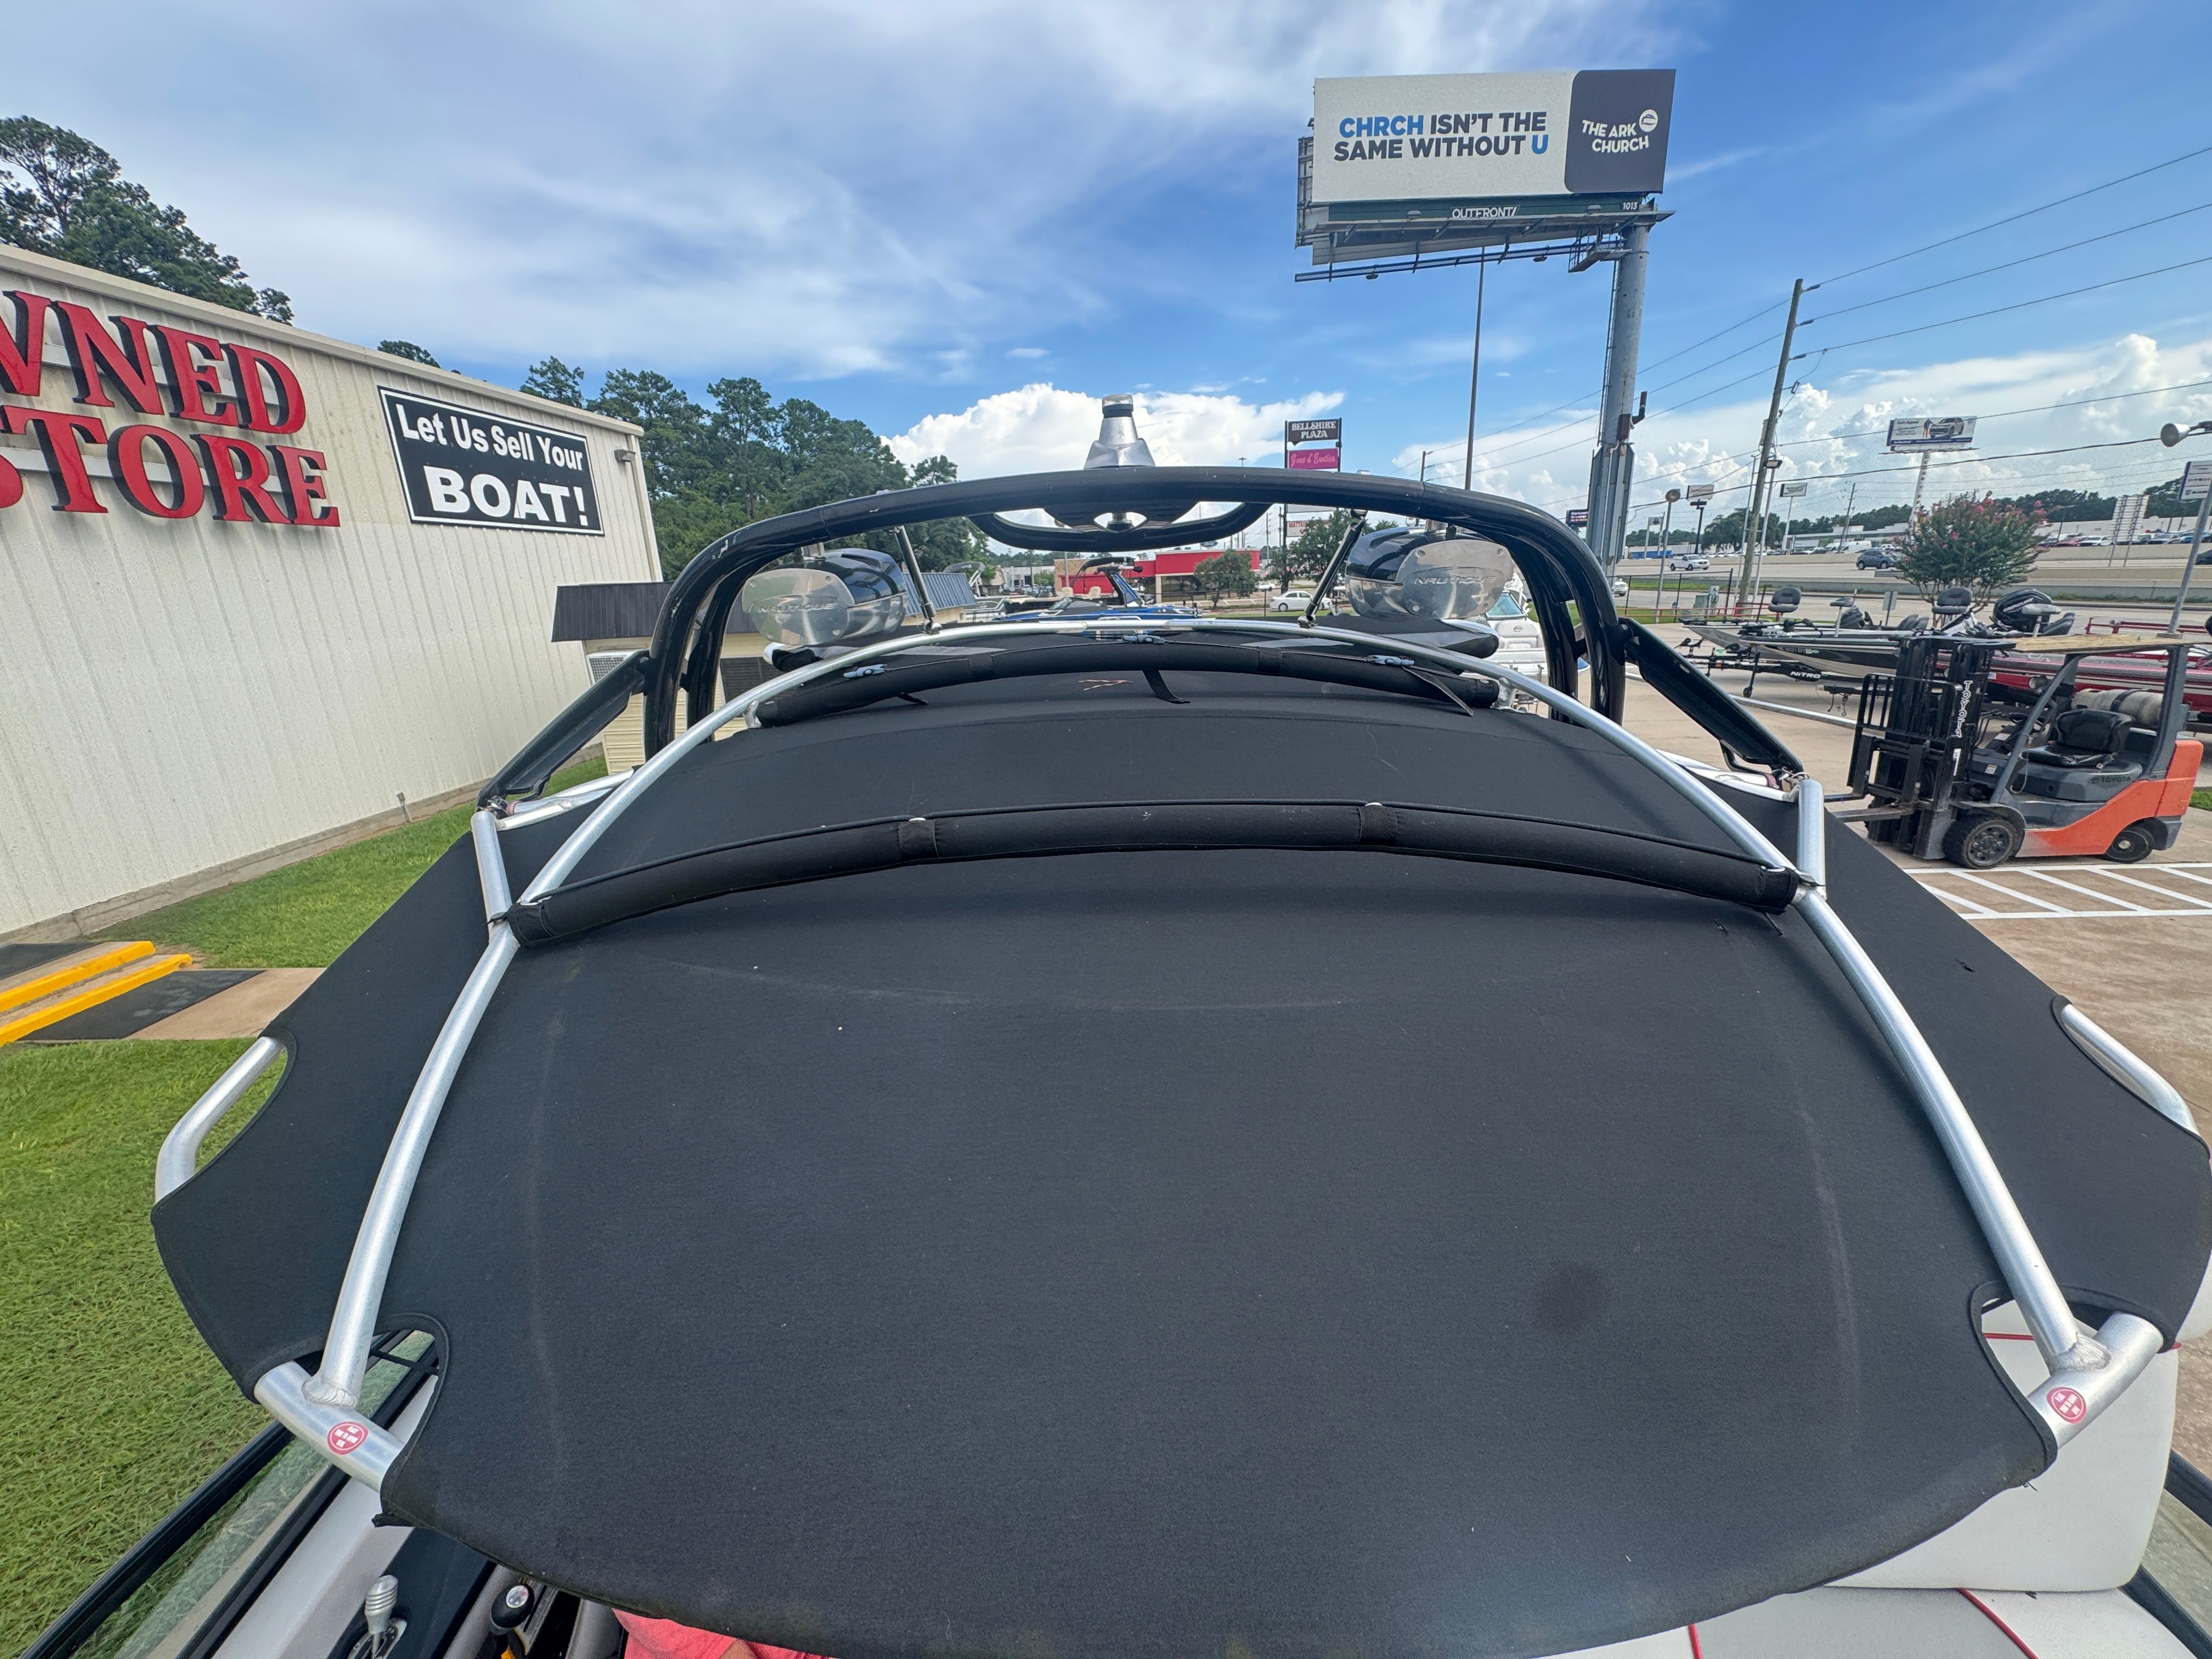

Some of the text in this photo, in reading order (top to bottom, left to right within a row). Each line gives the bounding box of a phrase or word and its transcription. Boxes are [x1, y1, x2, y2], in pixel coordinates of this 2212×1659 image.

[1339, 111, 1547, 138] CHRCH ISN'T THE
[1581, 119, 1637, 137] THE ARK
[1334, 134, 1549, 161] SAME WITHOUT U
[1592, 135, 1649, 153] CHURCH
[1622, 201, 1638, 210] 1013
[1291, 421, 1336, 431] BELLSHIRE
[1301, 430, 1328, 439] PLAZA
[396, 403, 583, 471] Let Us Sell Your
[0, 405, 341, 527] TORE
[423, 465, 589, 527] BOAT!
[1414, 576, 1497, 585] NAUTIQUE
[758, 602, 836, 613] NAUTIQUE
[1955, 680, 1974, 738] TOYOTA
